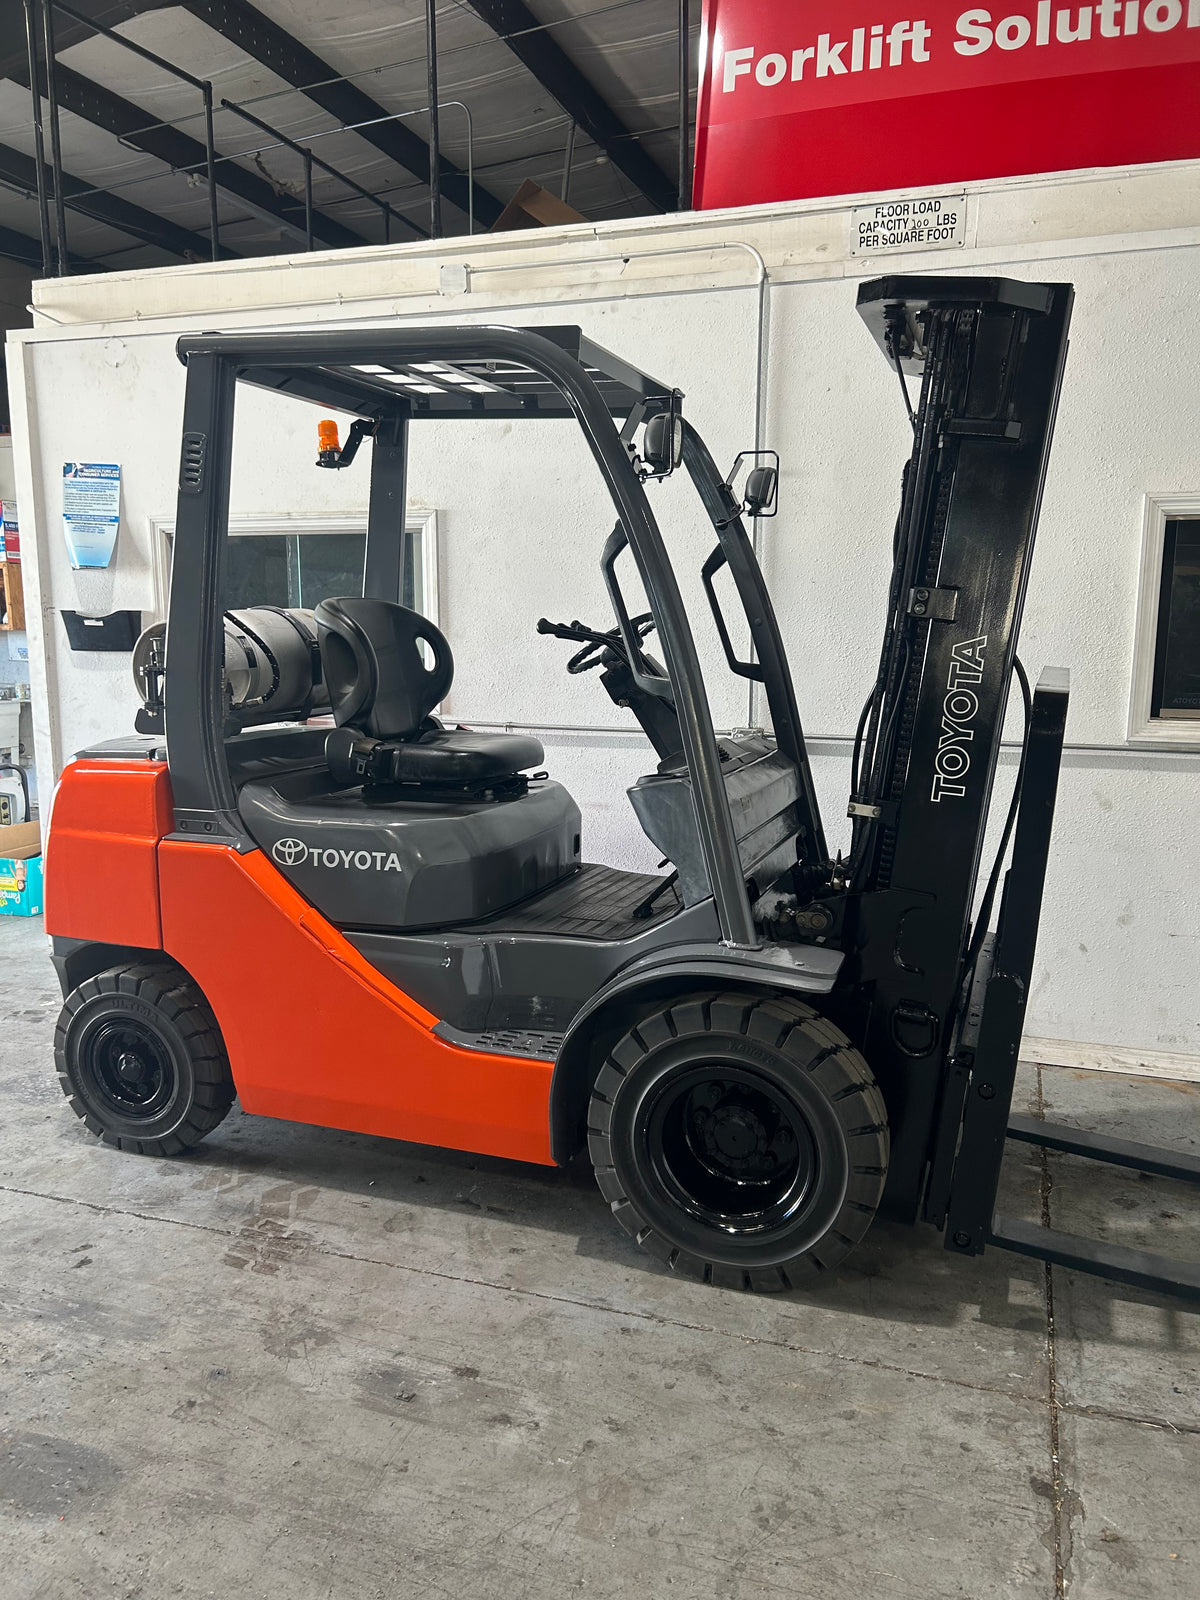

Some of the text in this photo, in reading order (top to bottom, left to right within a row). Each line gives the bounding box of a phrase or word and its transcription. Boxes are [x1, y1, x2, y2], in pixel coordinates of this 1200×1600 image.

[723, 20, 931, 93] Forklift
[875, 200, 941, 218] FLOOR LOAD
[858, 218, 909, 234] CAPACITY
[936, 213, 957, 226] LBS
[859, 227, 956, 247] PER SQUARE FOOT
[930, 635, 988, 802] TOYOTA
[309, 848, 402, 872] TOYOTA
